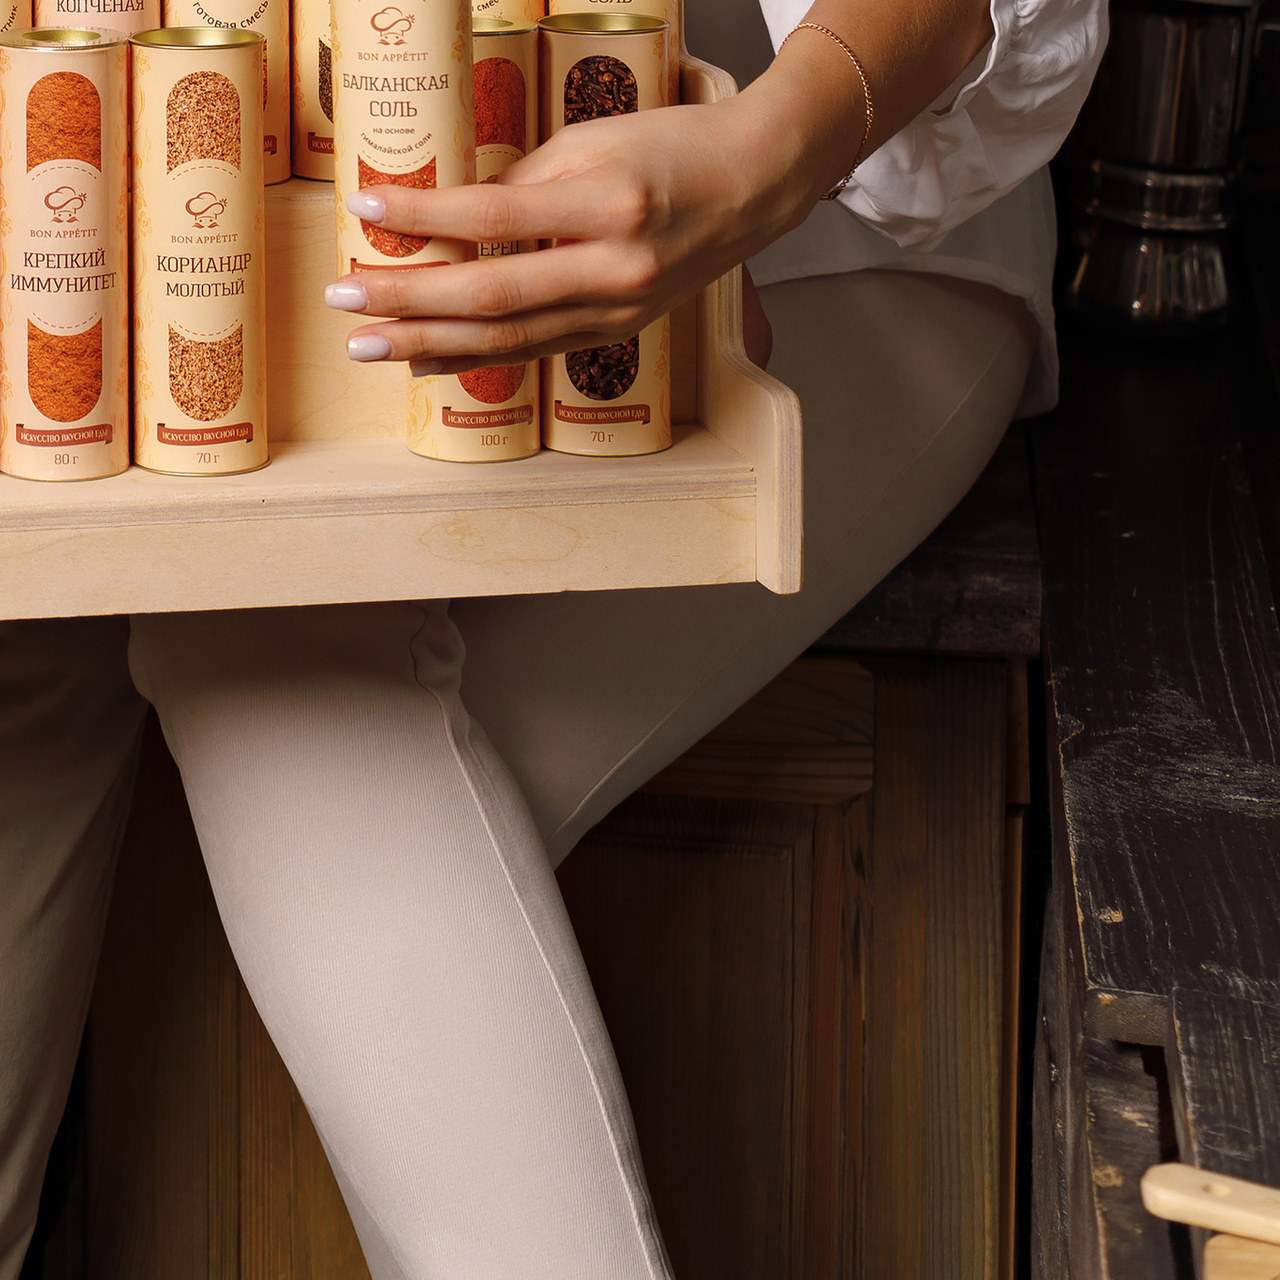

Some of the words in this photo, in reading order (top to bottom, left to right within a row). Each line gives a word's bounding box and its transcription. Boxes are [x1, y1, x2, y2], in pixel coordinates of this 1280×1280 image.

[240, 0, 269, 28] смесь
[357, 51, 379, 62] BON
[342, 73, 449, 92] БАЛКАНСКАЯ
[369, 100, 418, 118] СОЛЬ
[372, 126, 382, 134] на
[384, 126, 416, 134] основе
[360, 132, 413, 155] гималайской
[414, 131, 433, 151] соли
[30, 229, 52, 238] BON
[170, 235, 193, 244] BON
[23, 247, 106, 269] КРЕПКИЙ
[157, 253, 252, 275] КОРИАНДР
[10, 270, 118, 294] ИММУНИТЕТ
[166, 277, 245, 298] МОЛОТЫЙ
[448, 414, 490, 424] ИСКУССТВО
[558, 408, 596, 420] ИСКУССТВО
[20, 432, 60, 443] ИСКУССТВО
[162, 430, 202, 442] ИСКУССТВО
[480, 434, 501, 447] 100
[590, 430, 606, 443] 70
[54, 453, 70, 465] 80
[196, 452, 212, 464] 70
